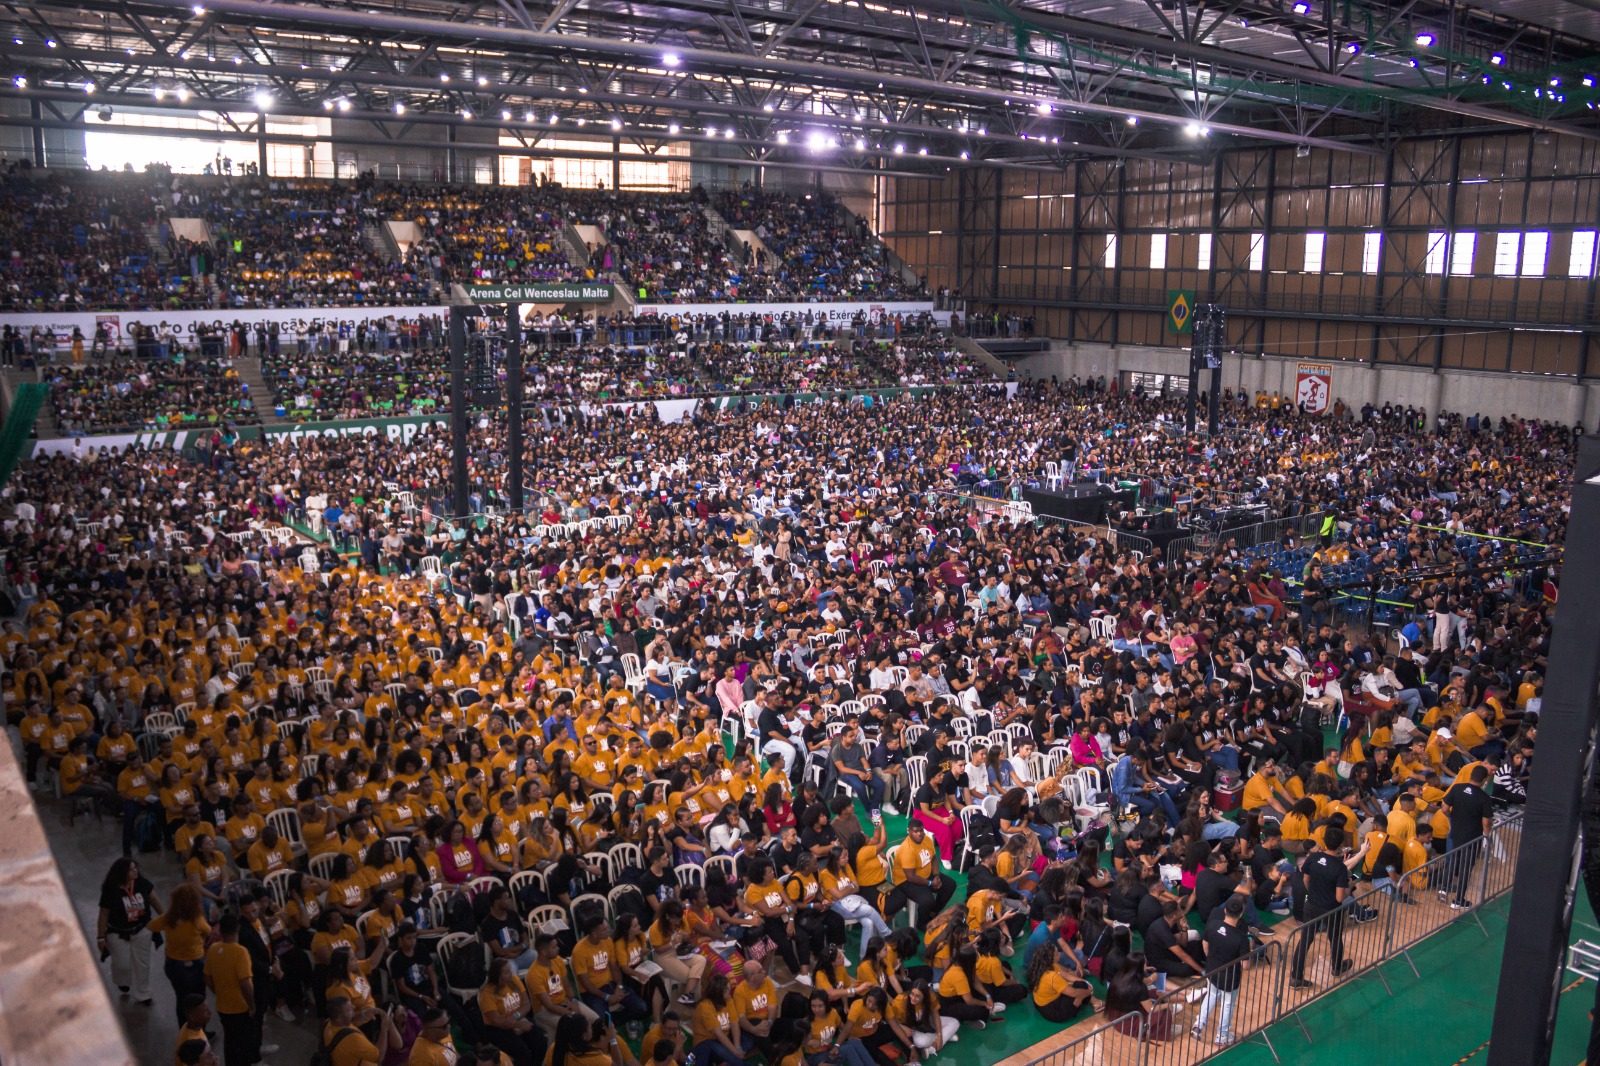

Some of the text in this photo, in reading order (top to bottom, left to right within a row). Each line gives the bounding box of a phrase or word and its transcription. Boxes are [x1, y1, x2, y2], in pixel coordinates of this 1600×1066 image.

[470, 287, 609, 298] Arena Cel Wenceslau Malta
